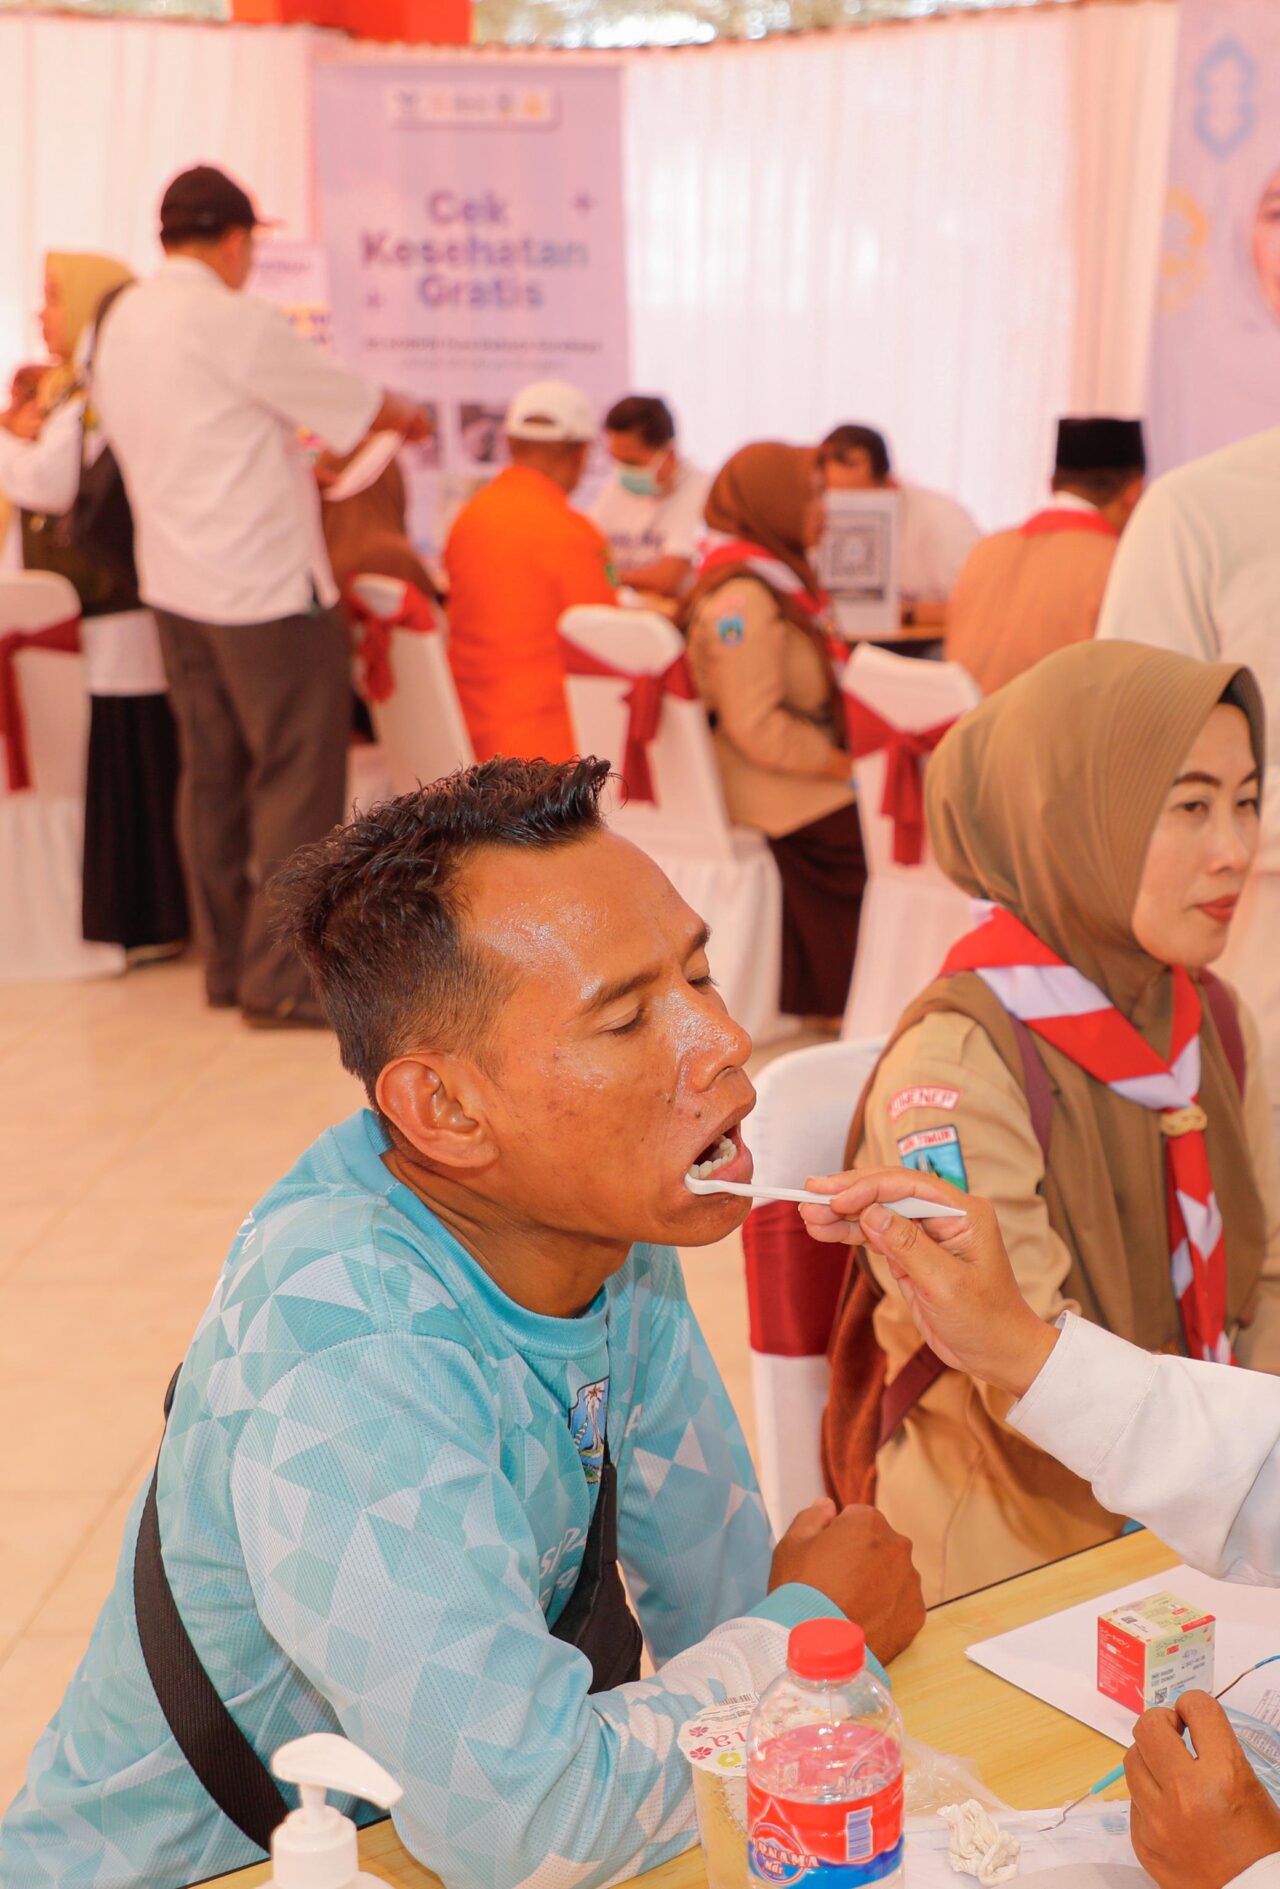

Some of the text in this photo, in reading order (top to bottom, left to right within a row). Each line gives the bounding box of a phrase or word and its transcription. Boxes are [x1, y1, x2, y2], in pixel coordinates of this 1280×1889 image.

[430, 190, 506, 223] Cek
[362, 231, 588, 267] Kesehatan
[420, 273, 545, 308] Gratis
